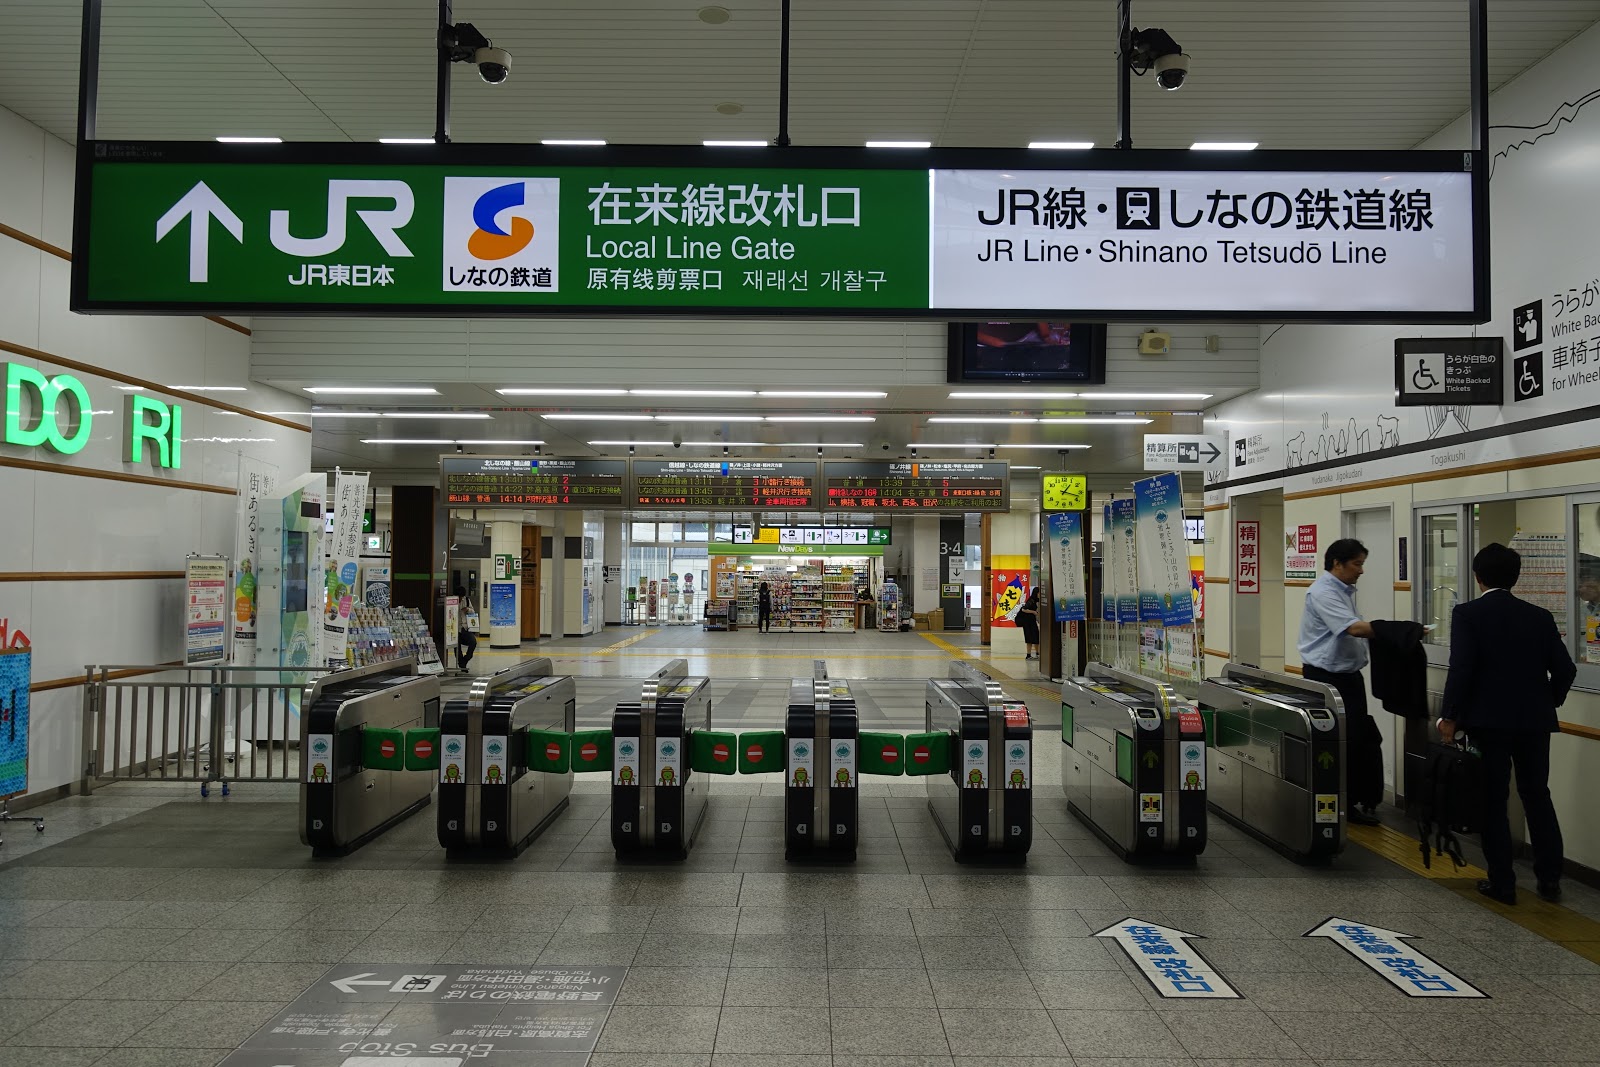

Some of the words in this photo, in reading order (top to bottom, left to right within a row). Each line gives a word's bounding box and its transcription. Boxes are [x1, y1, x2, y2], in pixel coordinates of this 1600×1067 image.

[587, 183, 861, 228] 在来線改札口
[270, 180, 415, 258] JR
[586, 235, 656, 260] Local
[666, 235, 722, 260] Line
[731, 235, 795, 260] Gate
[977, 239, 1015, 263] JR
[1216, 239, 1322, 264] Tetsudō
[1332, 240, 1387, 265] Line
[288, 264, 395, 287] JR東日本
[449, 266, 552, 288] しなの鉄道
[587, 267, 722, 291] 原有线剪票口
[743, 269, 808, 292] 재래선
[820, 269, 887, 292] 개찰구
[1551, 278, 1600, 318] うらが
[1551, 319, 1582, 338] White
[1446, 354, 1496, 364] うらが白色の
[1446, 366, 1471, 375] きっぷ
[1552, 377, 1566, 391] for
[131, 394, 182, 469] RI
[1146, 442, 1178, 453] 精算所
[1430, 449, 1466, 466] Togakushi
[562, 476, 570, 484] 2
[1335, 467, 1363, 483] Jigokudani
[499, 485, 523, 494] 14:22
[562, 485, 570, 494] 7
[880, 489, 903, 497] 14:04
[942, 489, 949, 497] 6
[476, 495, 491, 503] 普通
[499, 495, 523, 503] 14:14
[562, 495, 570, 504] 4
[689, 497, 713, 505] 13:55
[752, 497, 759, 505] 7
[247, 472, 260, 554] 街あるき
[337, 484, 353, 556] 街あるき
[344, 484, 361, 559] 善光寺表参道
[806, 531, 812, 539] 4
[778, 545, 814, 554] NewDays
[1239, 525, 1257, 577] 精算所
[998, 590, 1018, 612] 七味
[1121, 924, 1215, 994] 在来線改札口
[1330, 924, 1459, 993] 在来線改札口
[455, 974, 611, 985] 小布施・湯田中方面
[569, 968, 593, 976] For
[440, 989, 605, 1001] 長野電鉄のりば
[450, 983, 475, 991] Line
[535, 983, 584, 992] Nagano
[450, 1028, 590, 1039] 志賀高原・白馬方面
[429, 1042, 495, 1058] Bus
